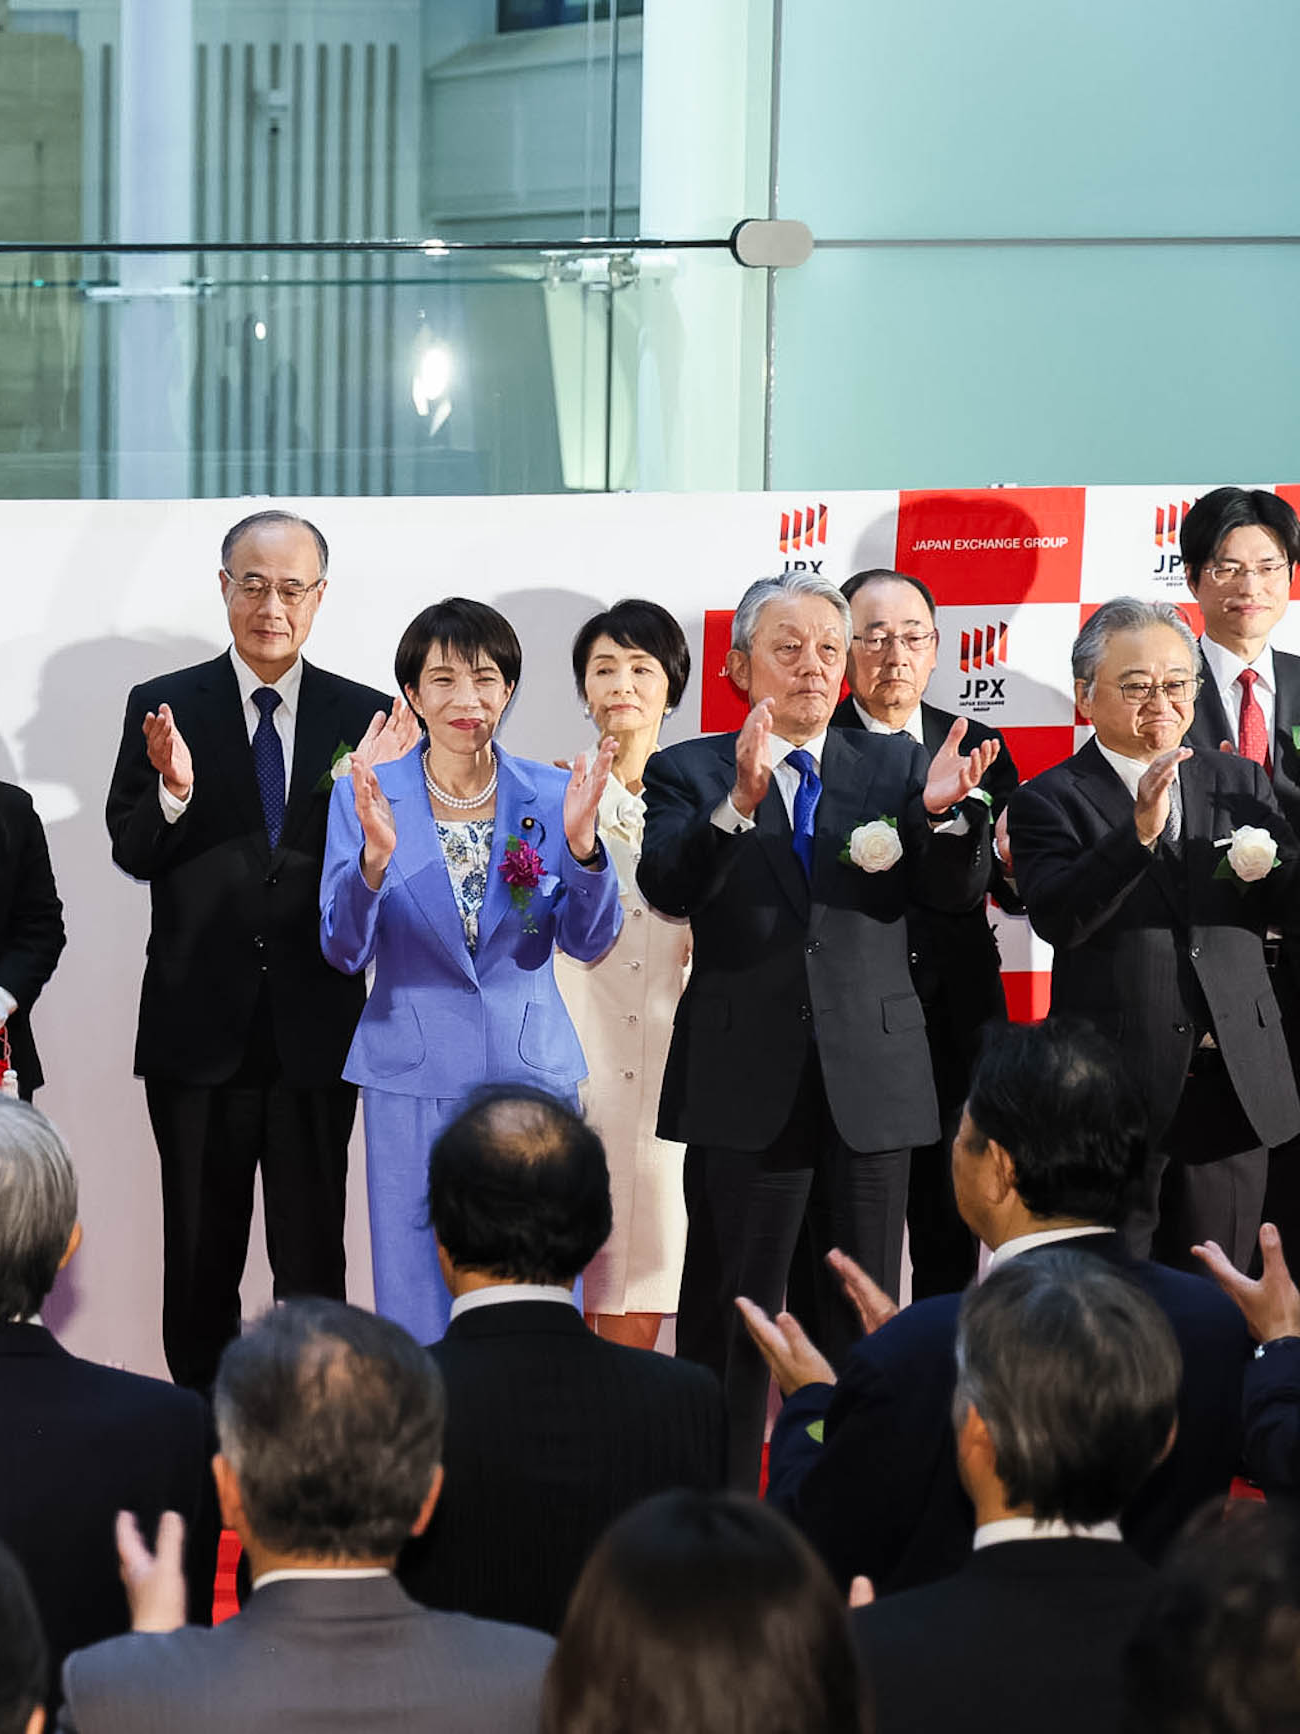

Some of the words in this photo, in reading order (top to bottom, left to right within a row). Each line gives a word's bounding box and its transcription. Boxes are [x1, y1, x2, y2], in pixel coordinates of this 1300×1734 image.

[912, 539, 951, 551] JAPAN
[954, 538, 1021, 550] EXCHANGE
[1023, 536, 1069, 549] GROUP
[1153, 554, 1185, 573] JP
[959, 678, 1005, 699] JPX
